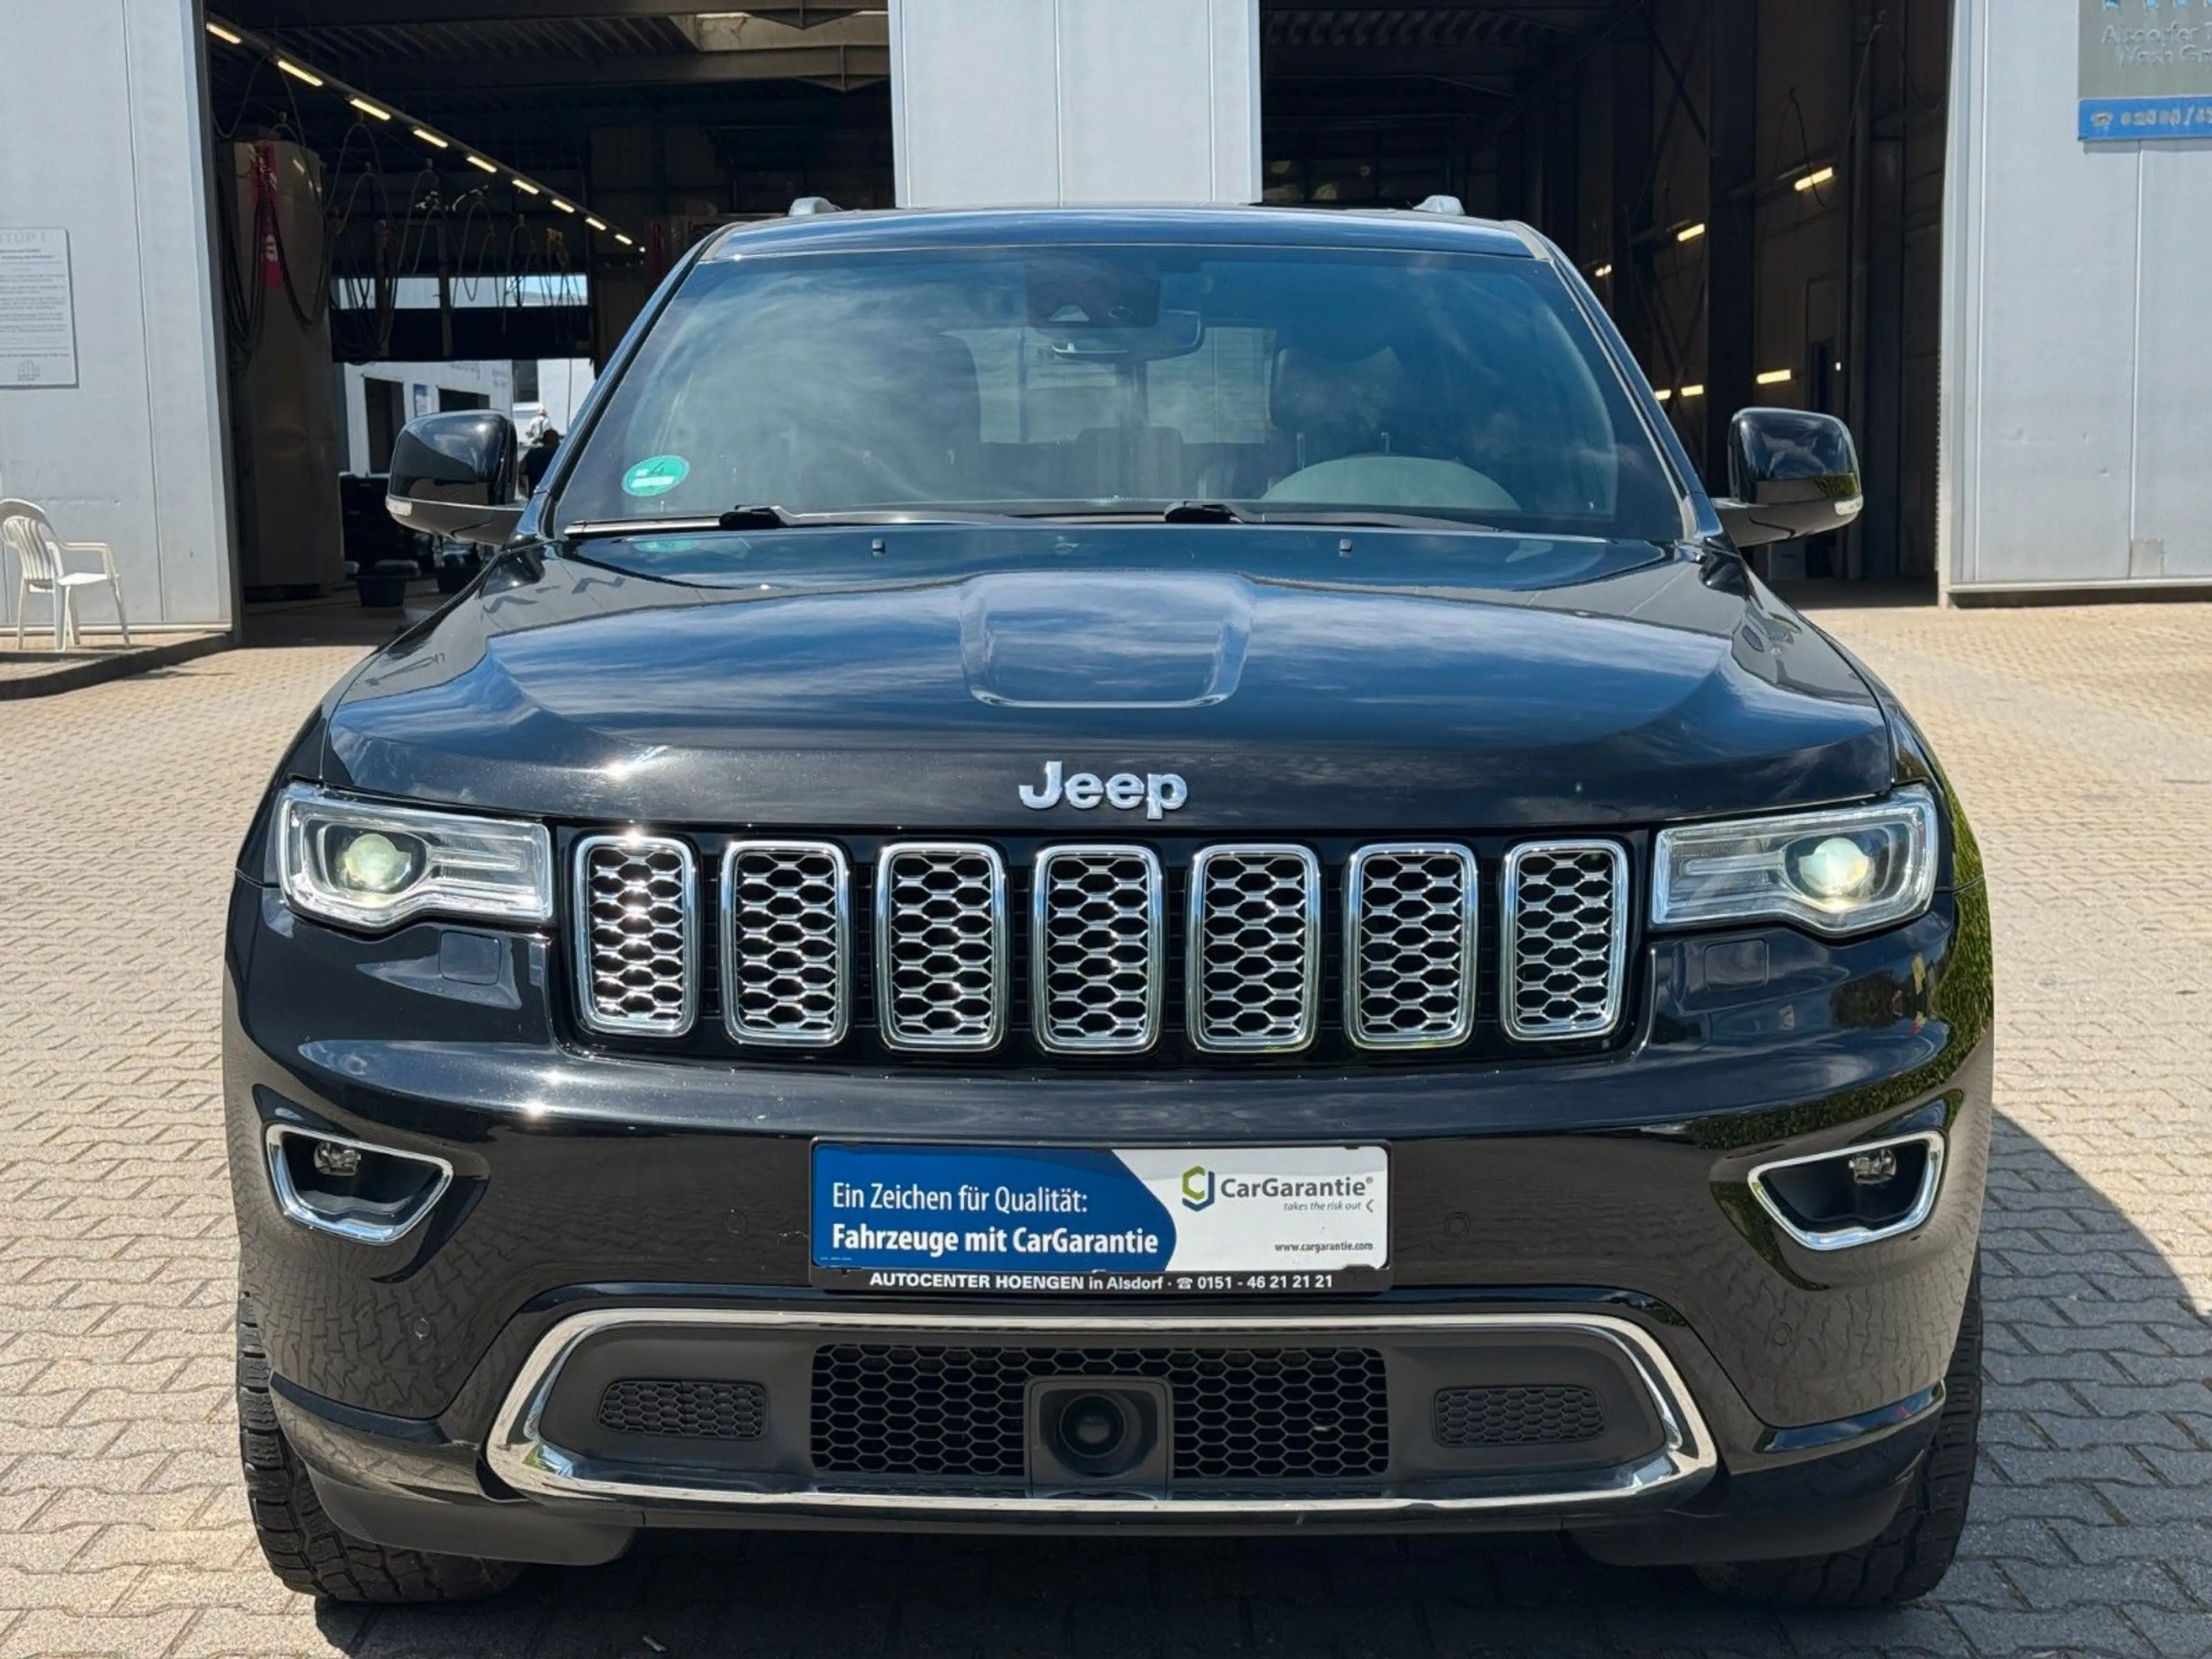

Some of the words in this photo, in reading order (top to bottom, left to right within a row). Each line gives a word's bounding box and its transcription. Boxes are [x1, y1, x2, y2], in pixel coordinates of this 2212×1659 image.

[1018, 761, 1187, 819] Jeep
[834, 1182, 864, 1208] Ein
[870, 1183, 952, 1210] Zeichen
[958, 1184, 990, 1211] für
[995, 1186, 1088, 1214] Qualität:
[1284, 1202, 1308, 1211] takes
[1310, 1202, 1325, 1211] the
[1327, 1201, 1343, 1210] risk
[1345, 1202, 1361, 1210] out
[833, 1223, 959, 1257] Fahrzeuge
[965, 1226, 1007, 1252] mit
[1013, 1227, 1158, 1253] CarGarantie
[1275, 1241, 1373, 1253] www.cargarantie.com
[870, 1272, 990, 1289] AUTOCENTER
[995, 1275, 1084, 1290] HOENGEN
[1089, 1277, 1103, 1289] in
[1107, 1277, 1164, 1290] Alsdorf
[1198, 1276, 1232, 1289] 0151
[1247, 1276, 1266, 1289] 46
[1270, 1275, 1287, 1288] 21
[1293, 1275, 1309, 1288] 21
[1315, 1275, 1332, 1287] 21
